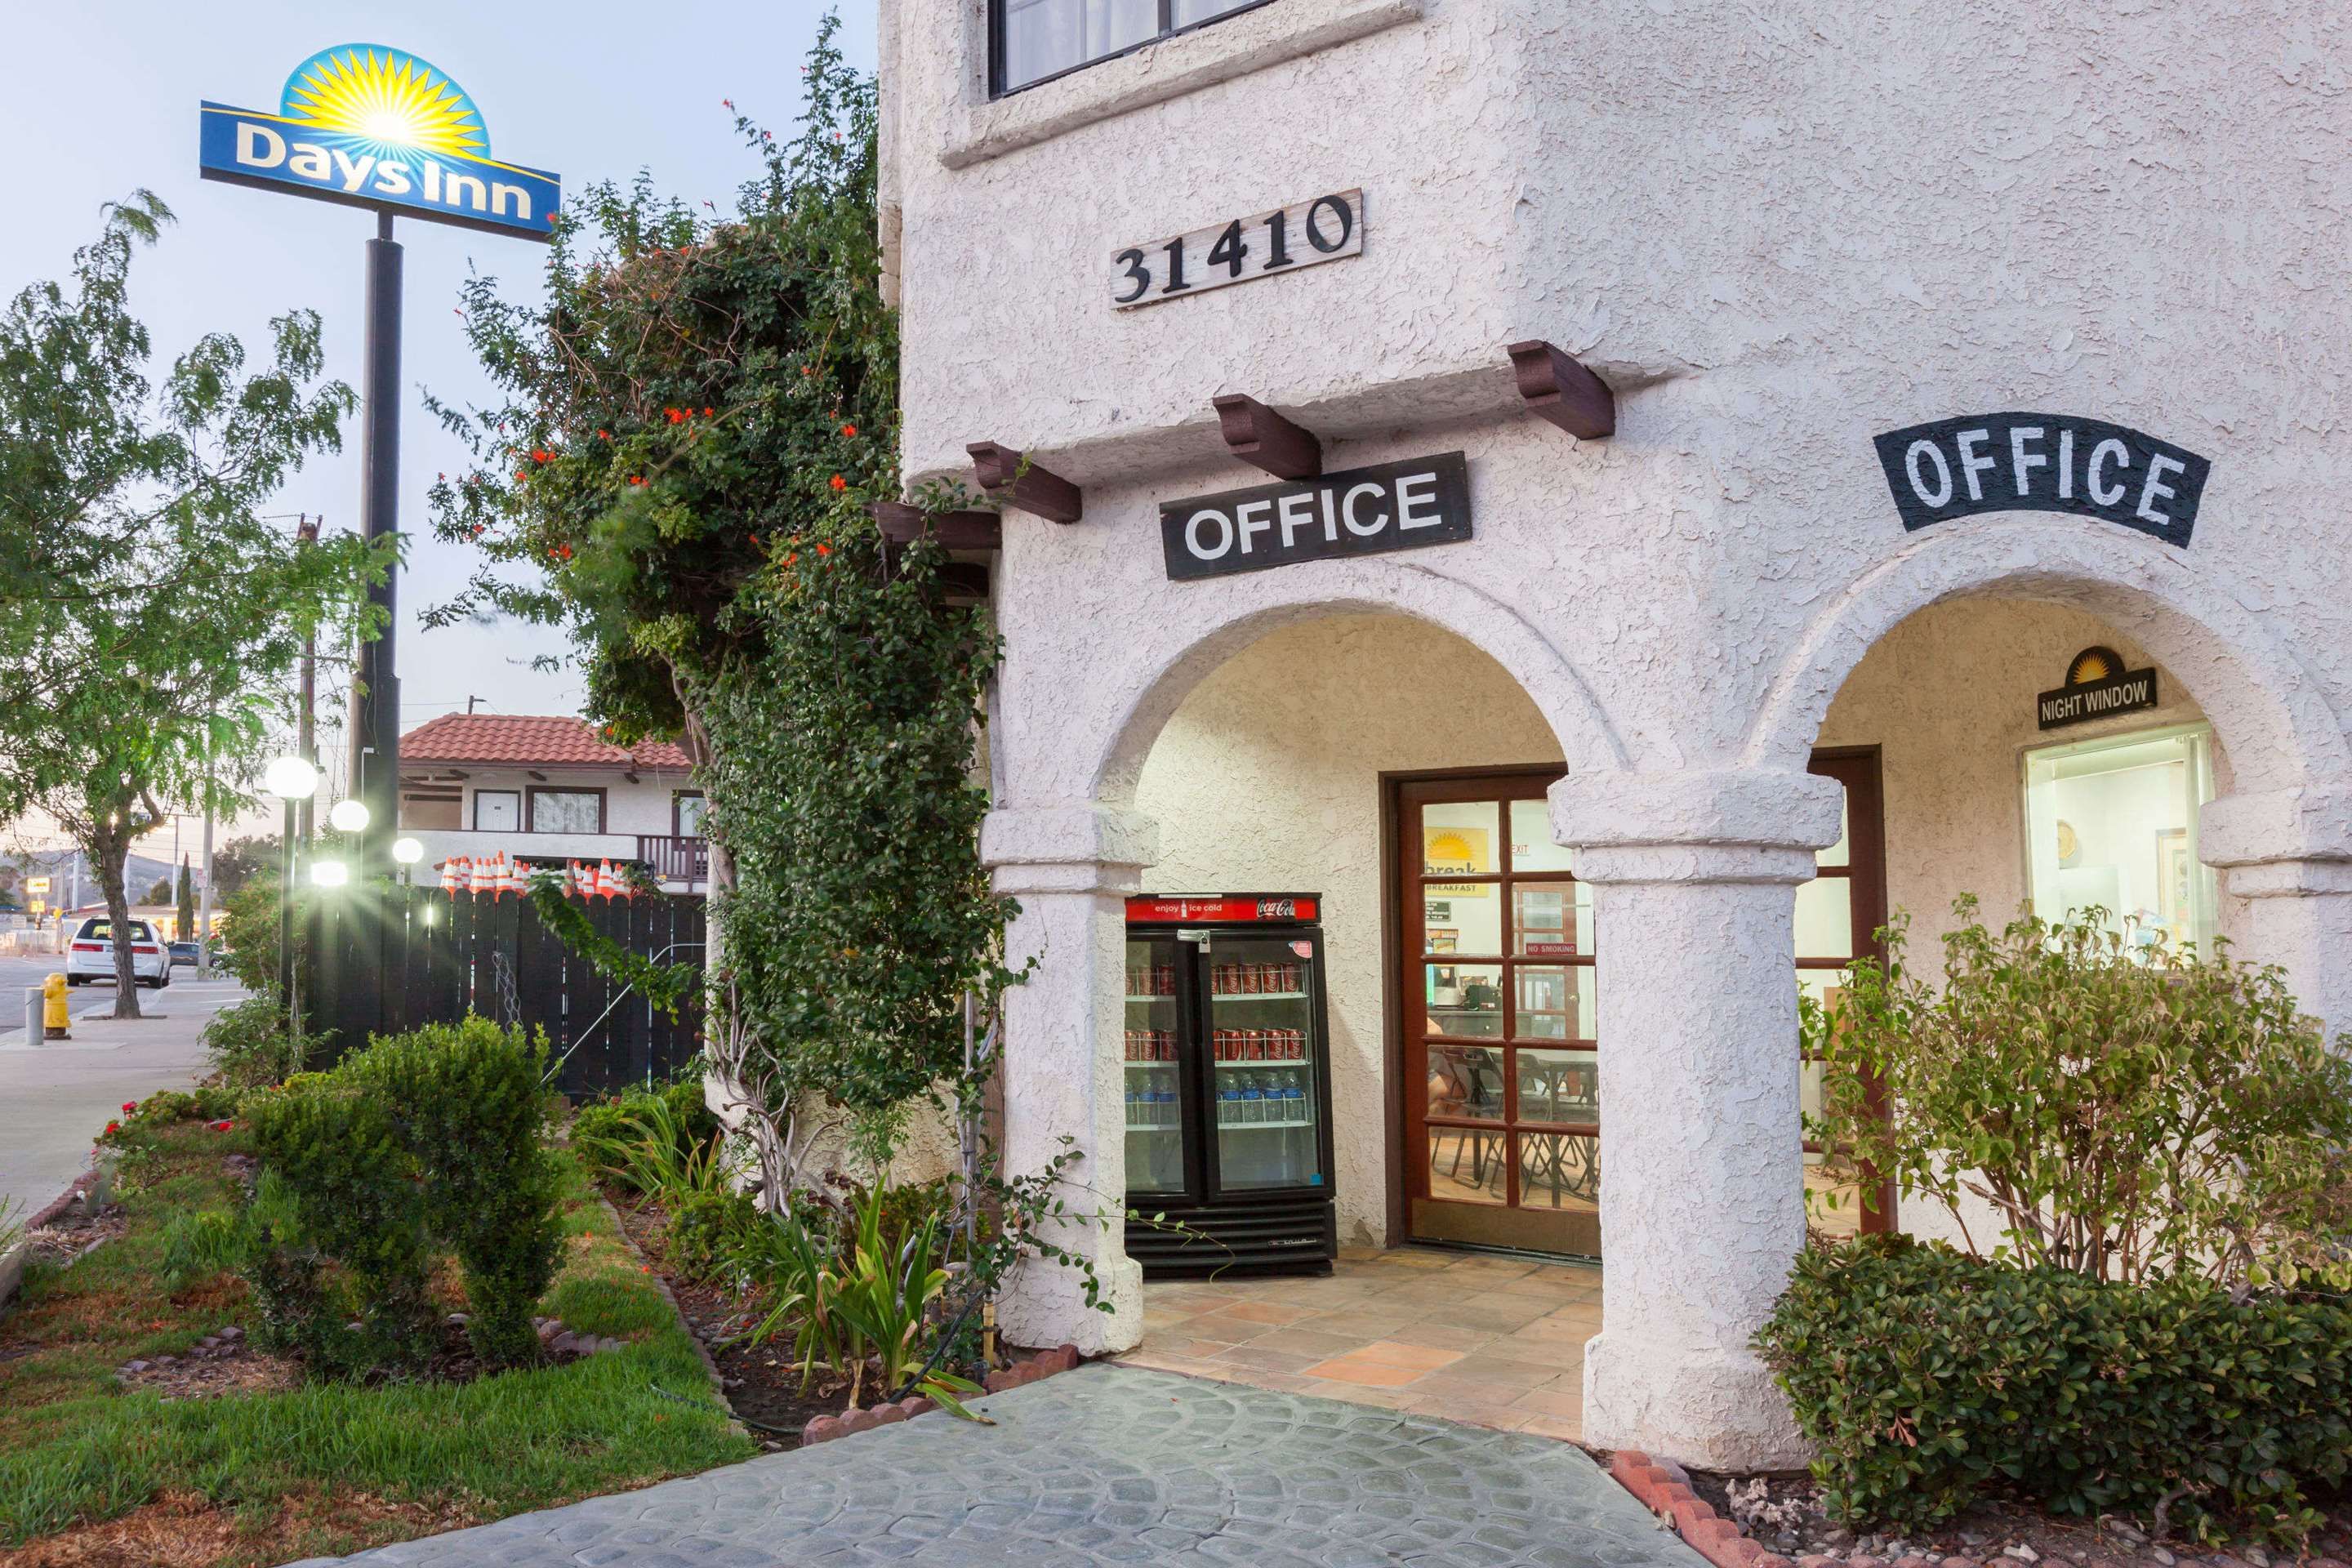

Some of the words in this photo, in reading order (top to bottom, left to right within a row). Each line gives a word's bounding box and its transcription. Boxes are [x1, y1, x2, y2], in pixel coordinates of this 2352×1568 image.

[235, 121, 412, 194] Days
[424, 160, 532, 220] Inn
[1115, 195, 1352, 303] 31410
[1185, 472, 1441, 560] OFFICE
[1905, 427, 2185, 526] OFFICE
[2042, 694, 2082, 722] NIGHT
[2086, 680, 2148, 713] WINDOW
[1512, 844, 1528, 854] EXIT
[1155, 904, 1178, 913] enjoy
